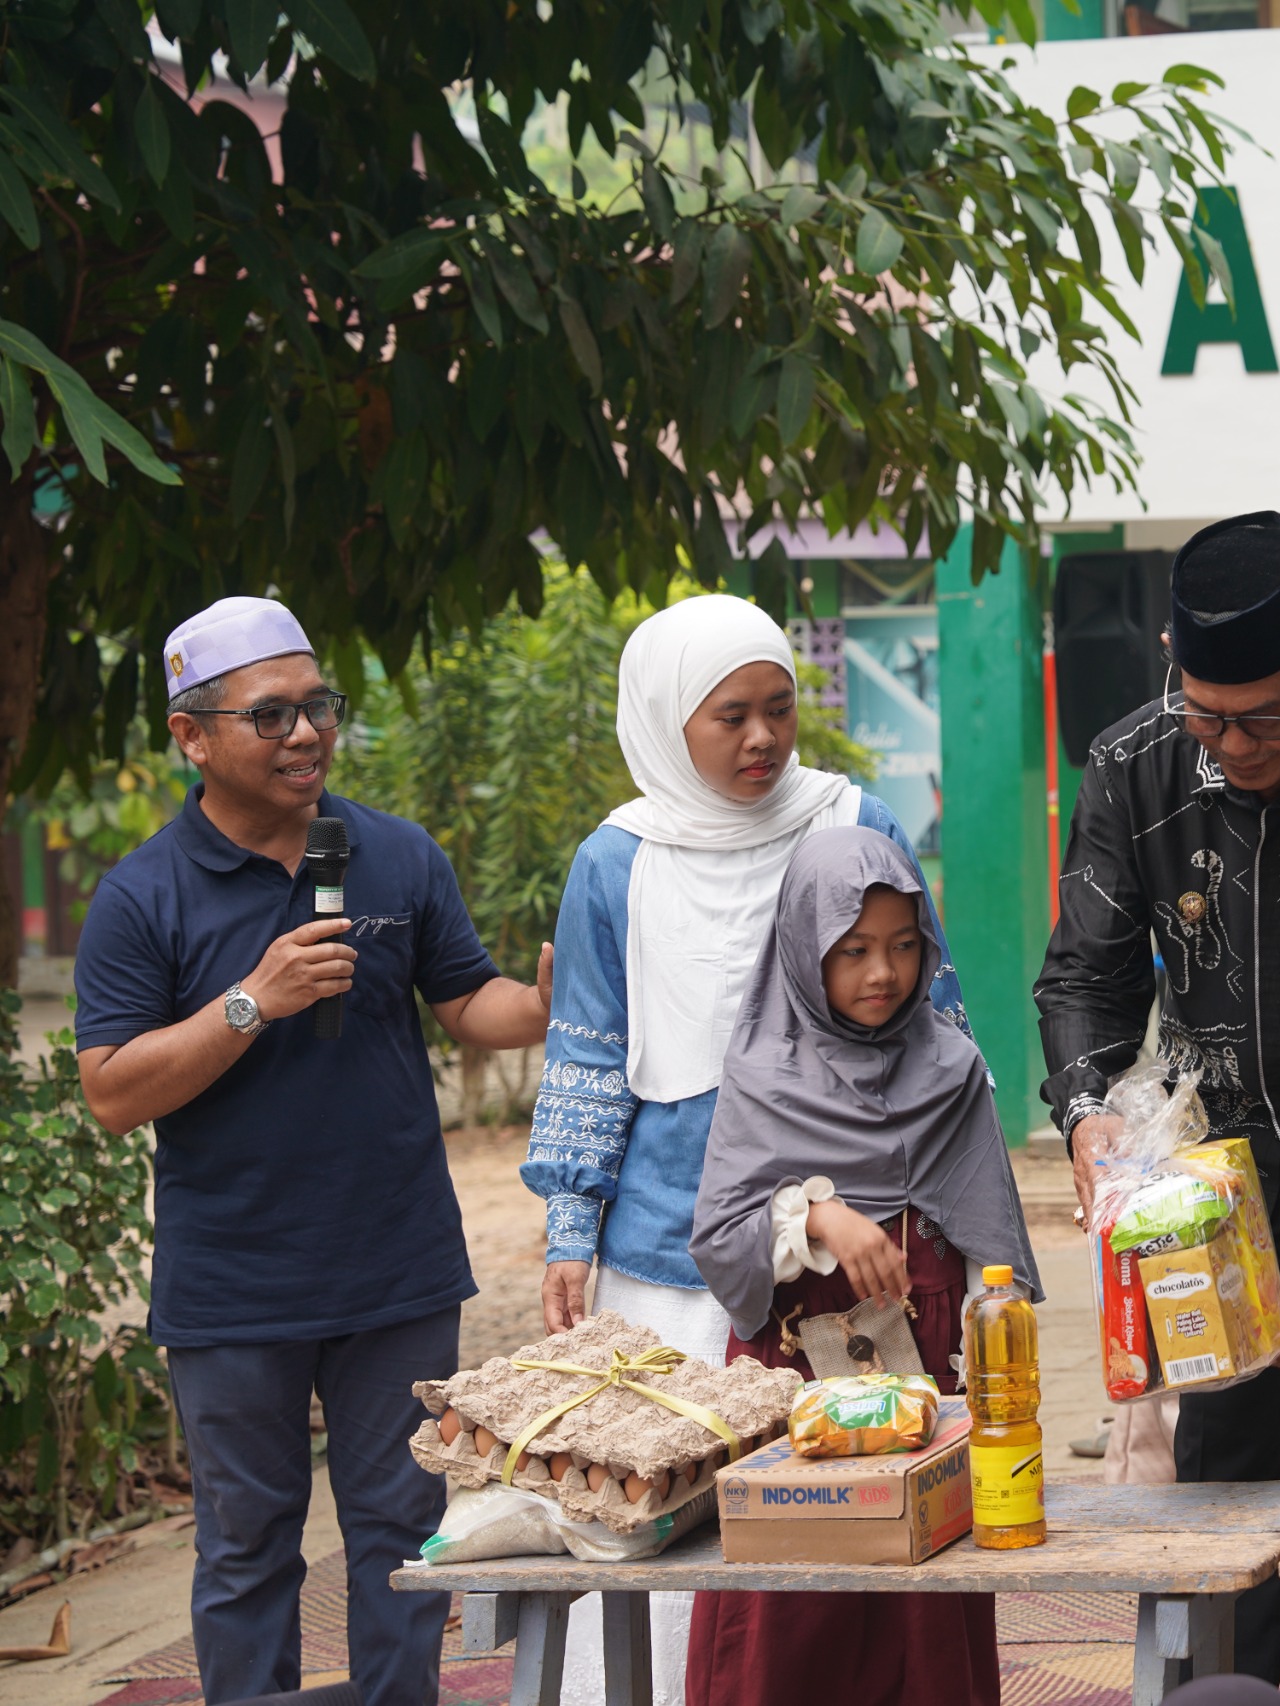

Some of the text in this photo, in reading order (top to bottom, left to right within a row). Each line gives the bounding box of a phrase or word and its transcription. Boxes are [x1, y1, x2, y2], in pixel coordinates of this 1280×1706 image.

[1120, 1249, 1132, 1287] Roma
[918, 1449, 966, 1496] INDOMILK
[726, 1487, 747, 1496] NKV
[762, 1487, 851, 1505] INDOMILK
